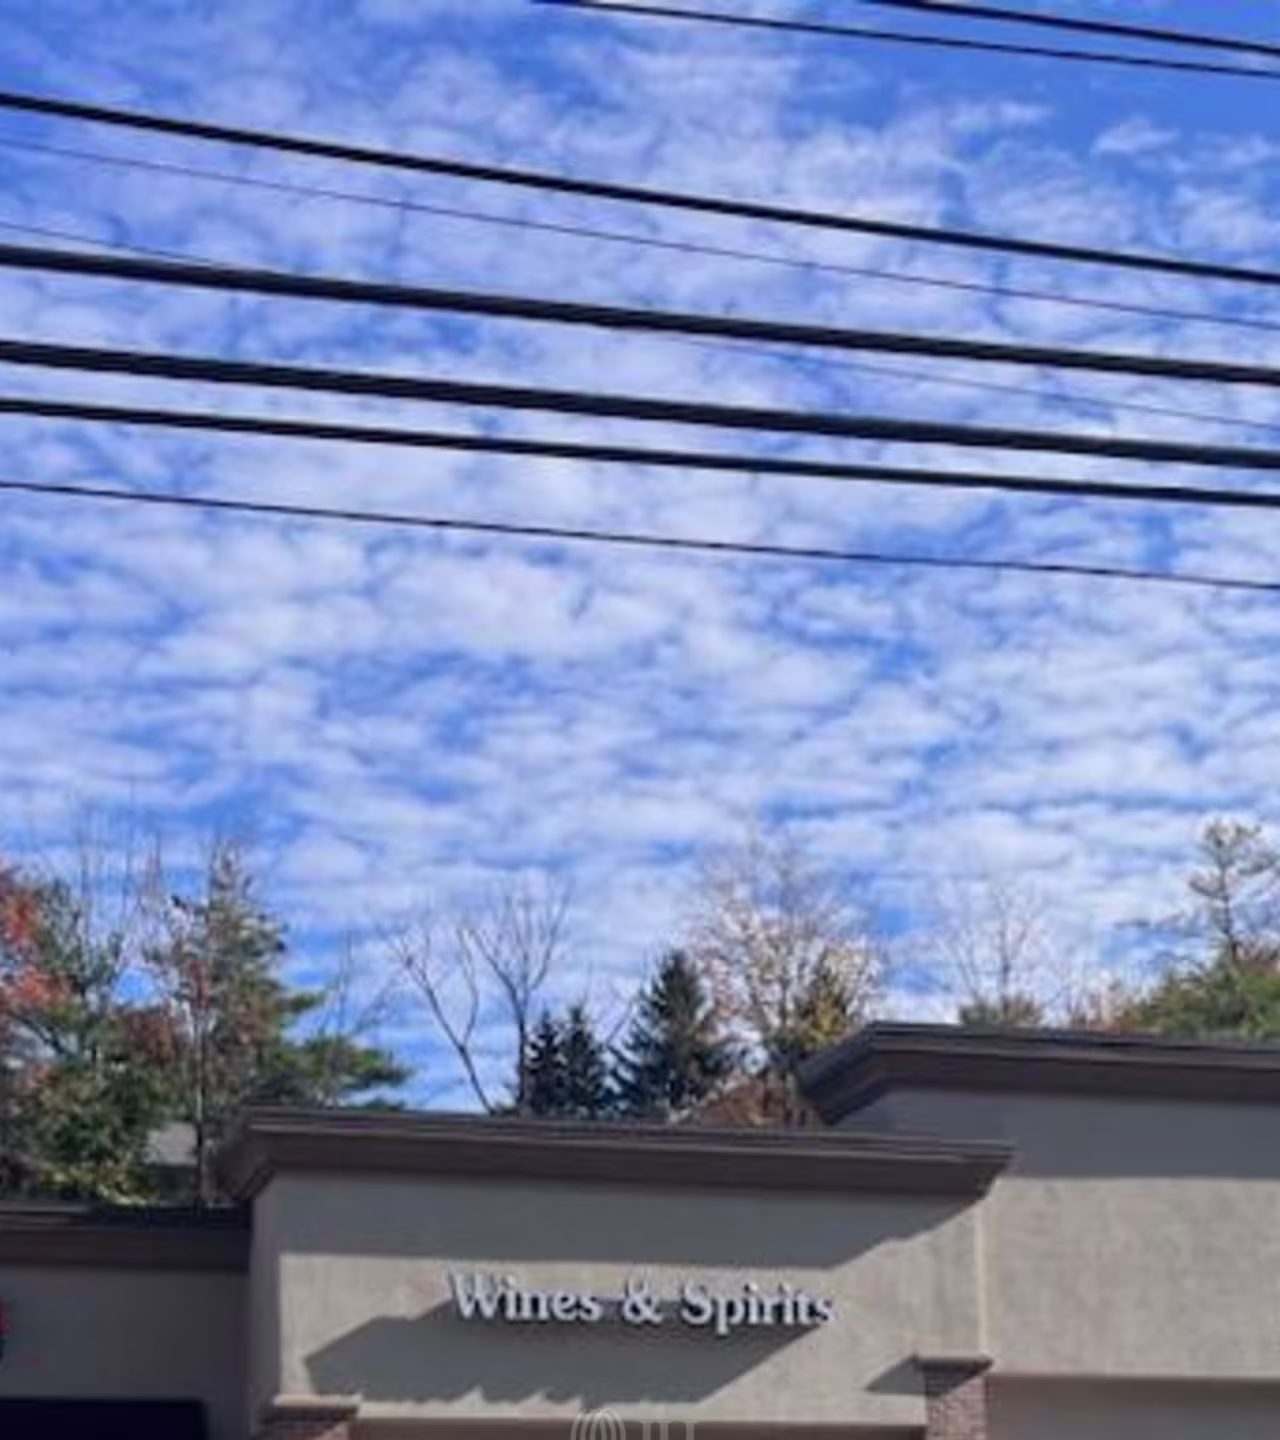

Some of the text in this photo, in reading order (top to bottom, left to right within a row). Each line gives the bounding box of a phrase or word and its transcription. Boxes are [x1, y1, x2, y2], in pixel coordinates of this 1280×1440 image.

[448, 1270, 838, 1335] Wines & Spirits
